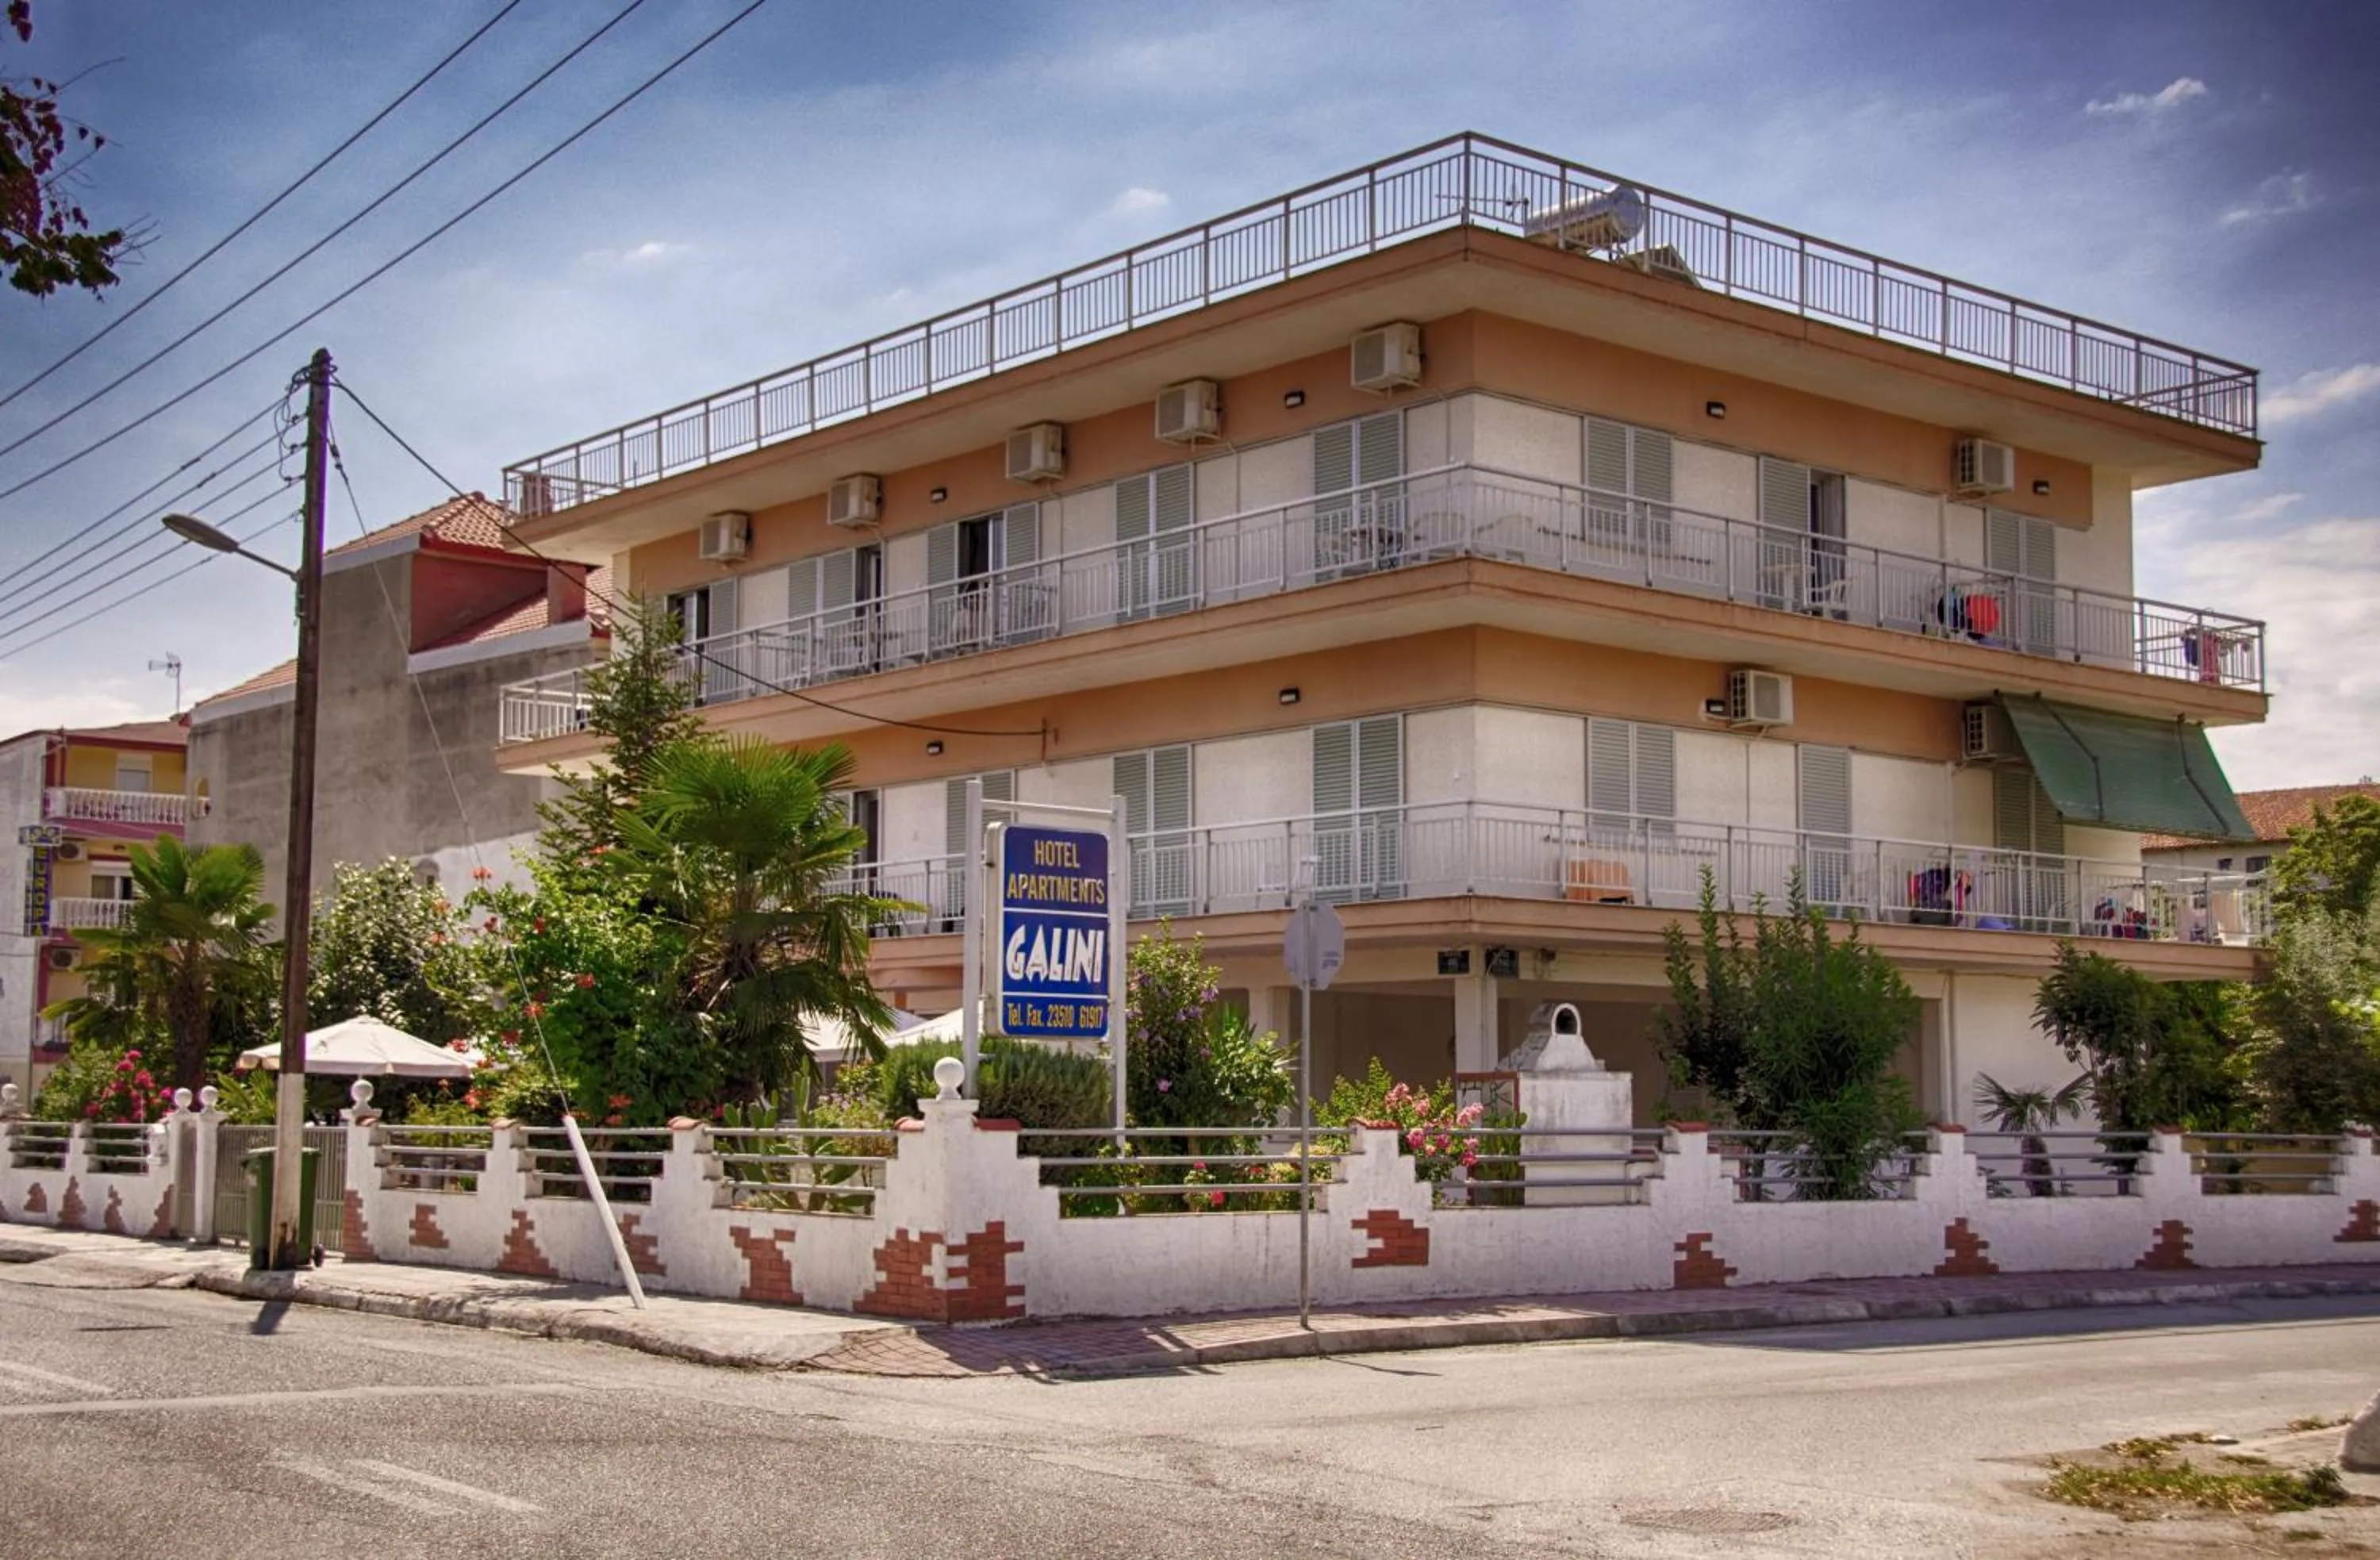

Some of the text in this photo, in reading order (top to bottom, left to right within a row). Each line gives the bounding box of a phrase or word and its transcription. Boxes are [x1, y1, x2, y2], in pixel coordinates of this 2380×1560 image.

[1035, 839, 1081, 869] HOTEL
[34, 847, 47, 937] EUROPA
[1007, 873, 1105, 905] APARTMENTS
[1006, 924, 1104, 984] GALINI
[1008, 1002, 1023, 1026] Tel.
[1027, 1003, 1044, 1027] Fax.
[1047, 1004, 1074, 1028] 23510
